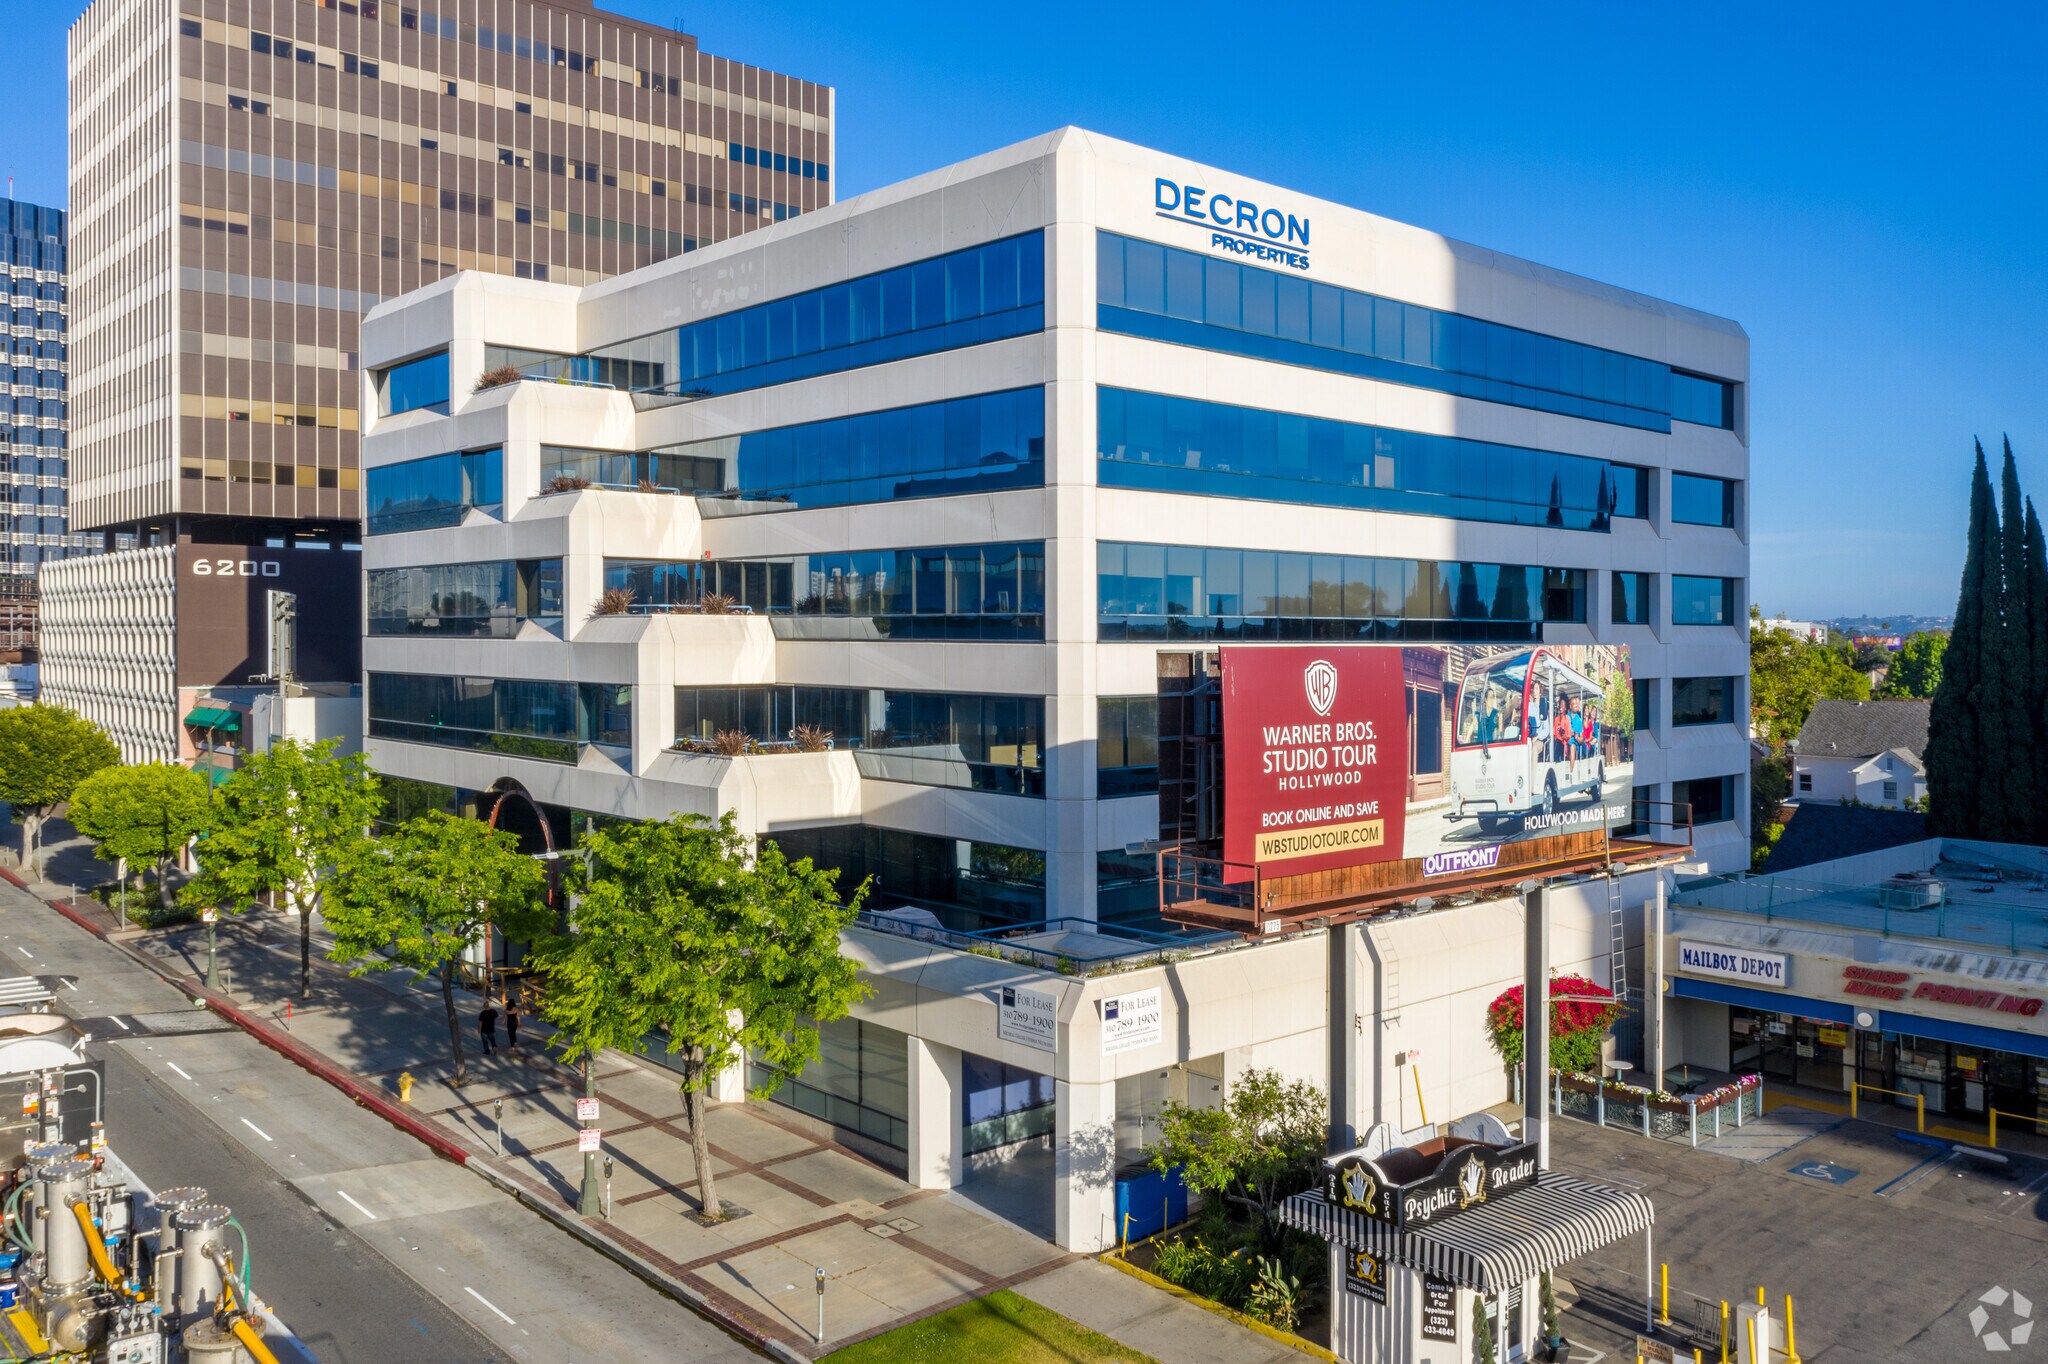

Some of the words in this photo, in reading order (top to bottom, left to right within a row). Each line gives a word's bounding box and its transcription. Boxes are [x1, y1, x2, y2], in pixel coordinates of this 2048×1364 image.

[1155, 177, 1309, 246] DECRON
[1212, 233, 1310, 270] PROPERTIES
[193, 559, 280, 576] 6200
[1263, 724, 1331, 746] WARNER
[1336, 721, 1377, 741] BROS.
[1263, 747, 1328, 773] STUDIO
[1332, 744, 1377, 767] TOUR
[1279, 771, 1361, 790] HOLLYWOOD
[1263, 811, 1293, 827] BOOK
[1296, 806, 1331, 823] ONLINE
[1333, 803, 1355, 819] AND
[1356, 801, 1378, 816] SAVE
[1524, 811, 1578, 830] HOLLYWOOD
[1580, 808, 1604, 823] MADE
[1607, 806, 1625, 819] HERE
[1263, 826, 1379, 856] WBSTUDIOTOUR.COM
[1425, 847, 1497, 873] OUTFRONT
[1683, 948, 1737, 972] MAILBOX
[1741, 957, 1781, 979] DEPOT
[1842, 965, 1910, 985] SHARP
[1843, 980, 1907, 1001] IMAGE
[1912, 982, 2045, 1017] PRINTING
[1012, 1010, 1055, 1030] 789-1900
[1328, 1173, 1337, 1201] Palm
[1405, 1187, 1457, 1221] Psychic
[1492, 1158, 1535, 1189] Reader
[1426, 1281, 1446, 1291] Come
[1430, 1291, 1438, 1299] Or
[1437, 1292, 1449, 1300] Call
[1433, 1299, 1448, 1308] For
[1423, 1324, 1456, 1337] 433-4049
[1430, 1315, 1449, 1328] (323)
